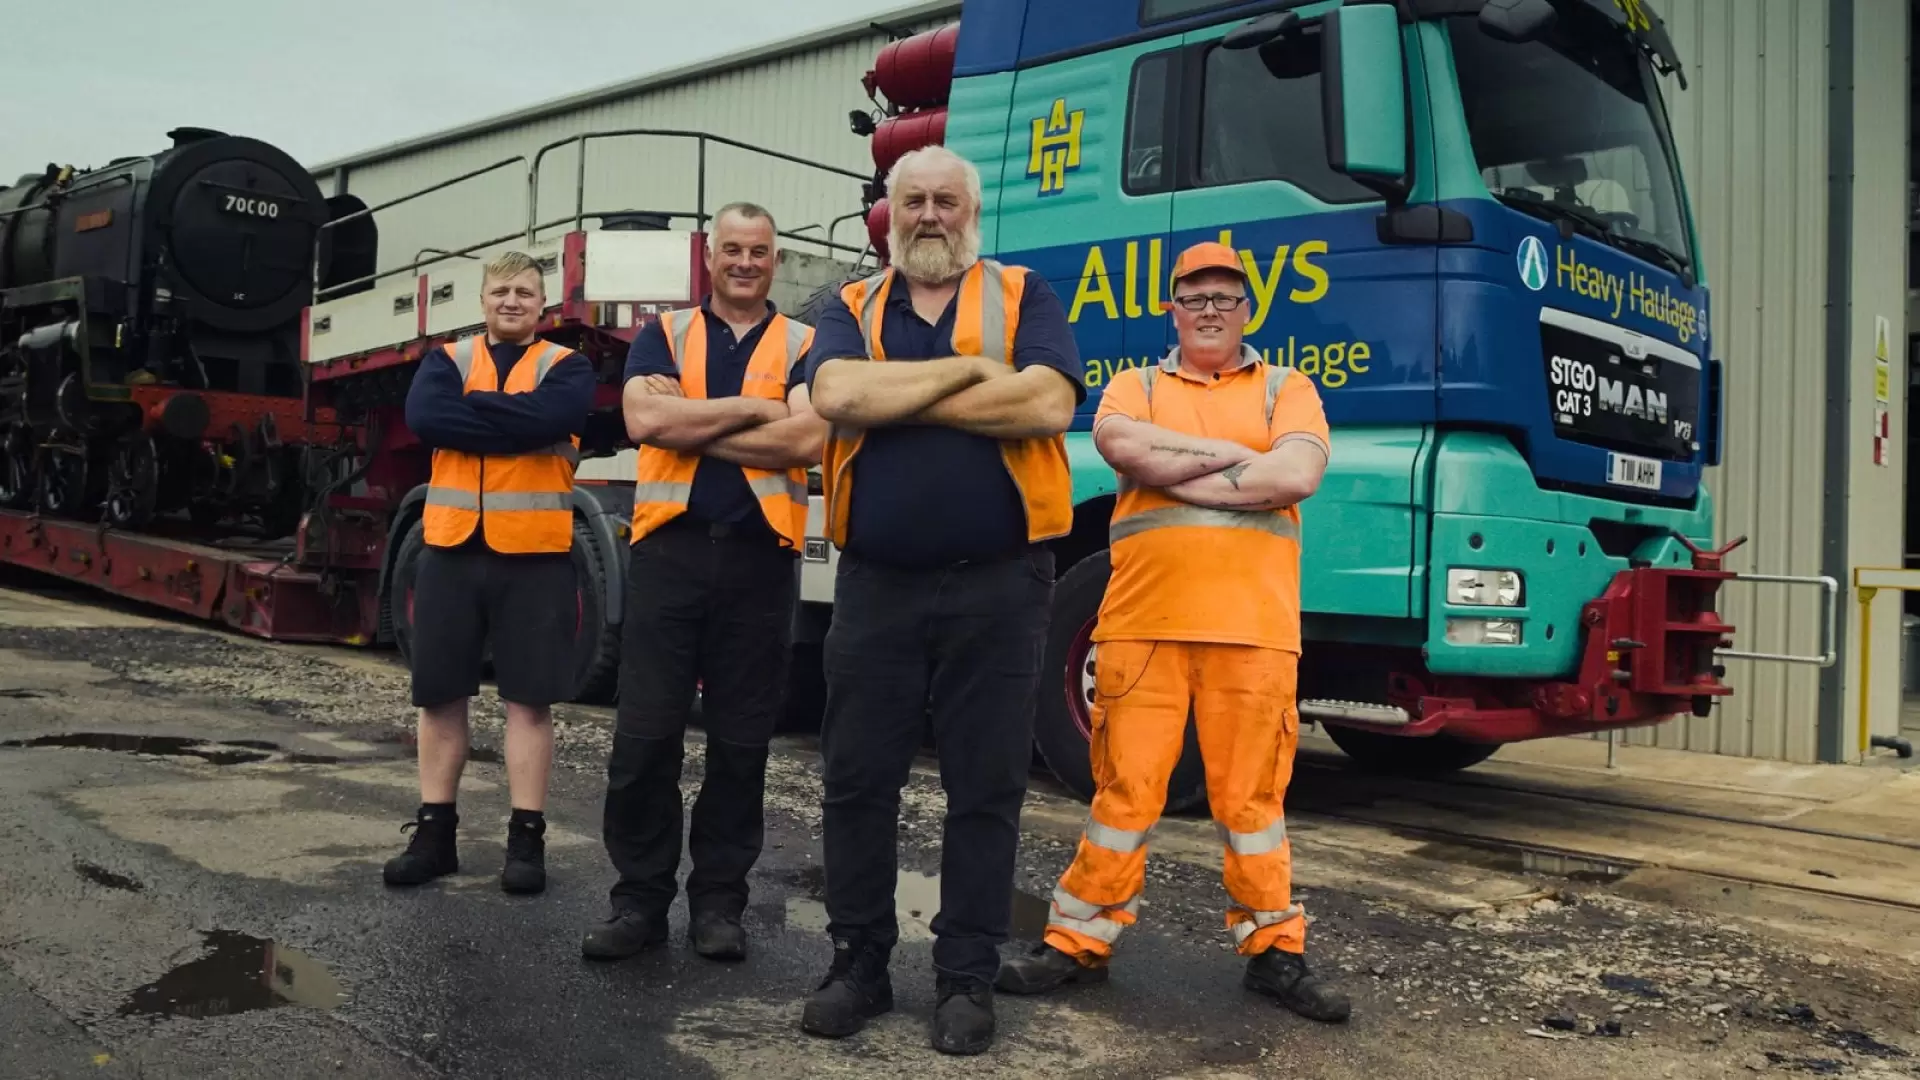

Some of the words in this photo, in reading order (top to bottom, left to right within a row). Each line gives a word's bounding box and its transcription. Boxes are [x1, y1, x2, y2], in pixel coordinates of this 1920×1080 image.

[1556, 244, 1624, 319] Heavy
[1629, 271, 1697, 343] Haulage
[1550, 355, 1596, 392] STGO
[1556, 390, 1581, 414] CAT
[1583, 395, 1592, 416] 3
[1598, 376, 1668, 424] MAN
